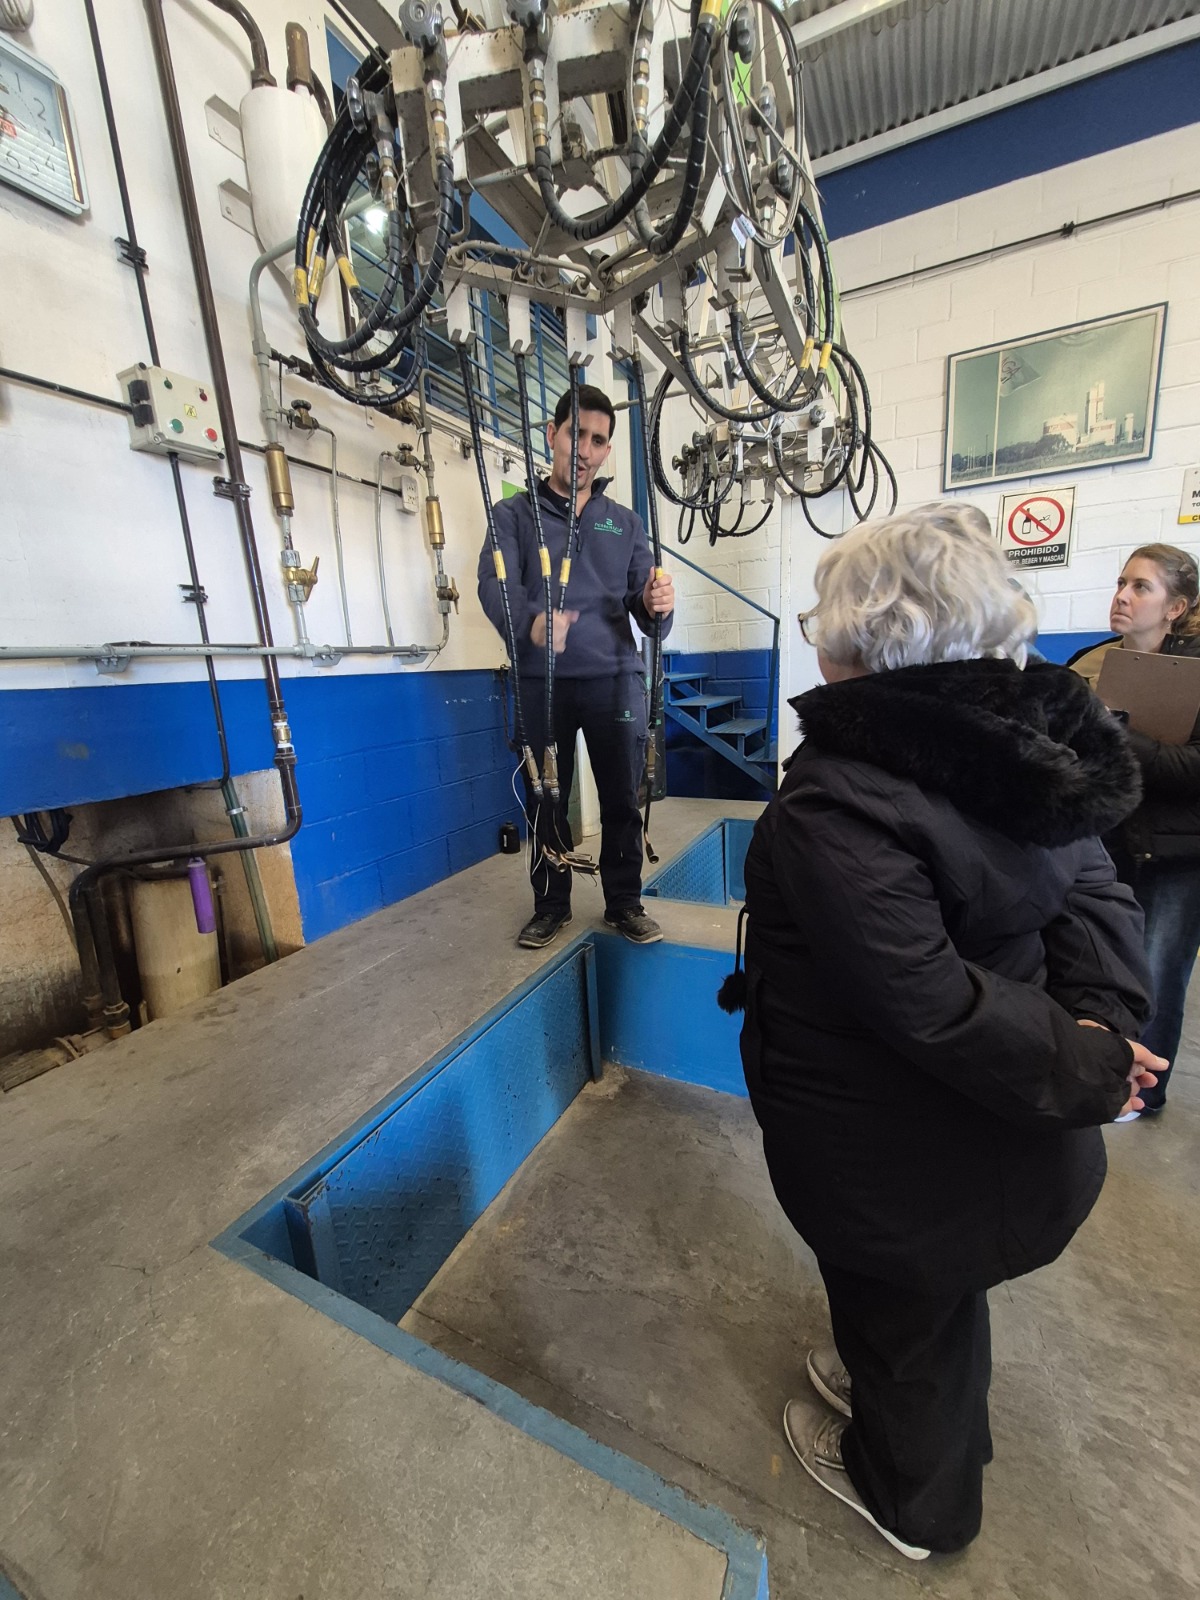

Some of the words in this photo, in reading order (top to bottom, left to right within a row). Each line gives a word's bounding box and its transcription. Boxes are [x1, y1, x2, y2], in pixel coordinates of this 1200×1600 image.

[33, 97, 46, 121] 2
[1191, 514, 1200, 522] C
[1008, 545, 1060, 558] PROHIBIDO
[1043, 553, 1065, 563] MASCAR
